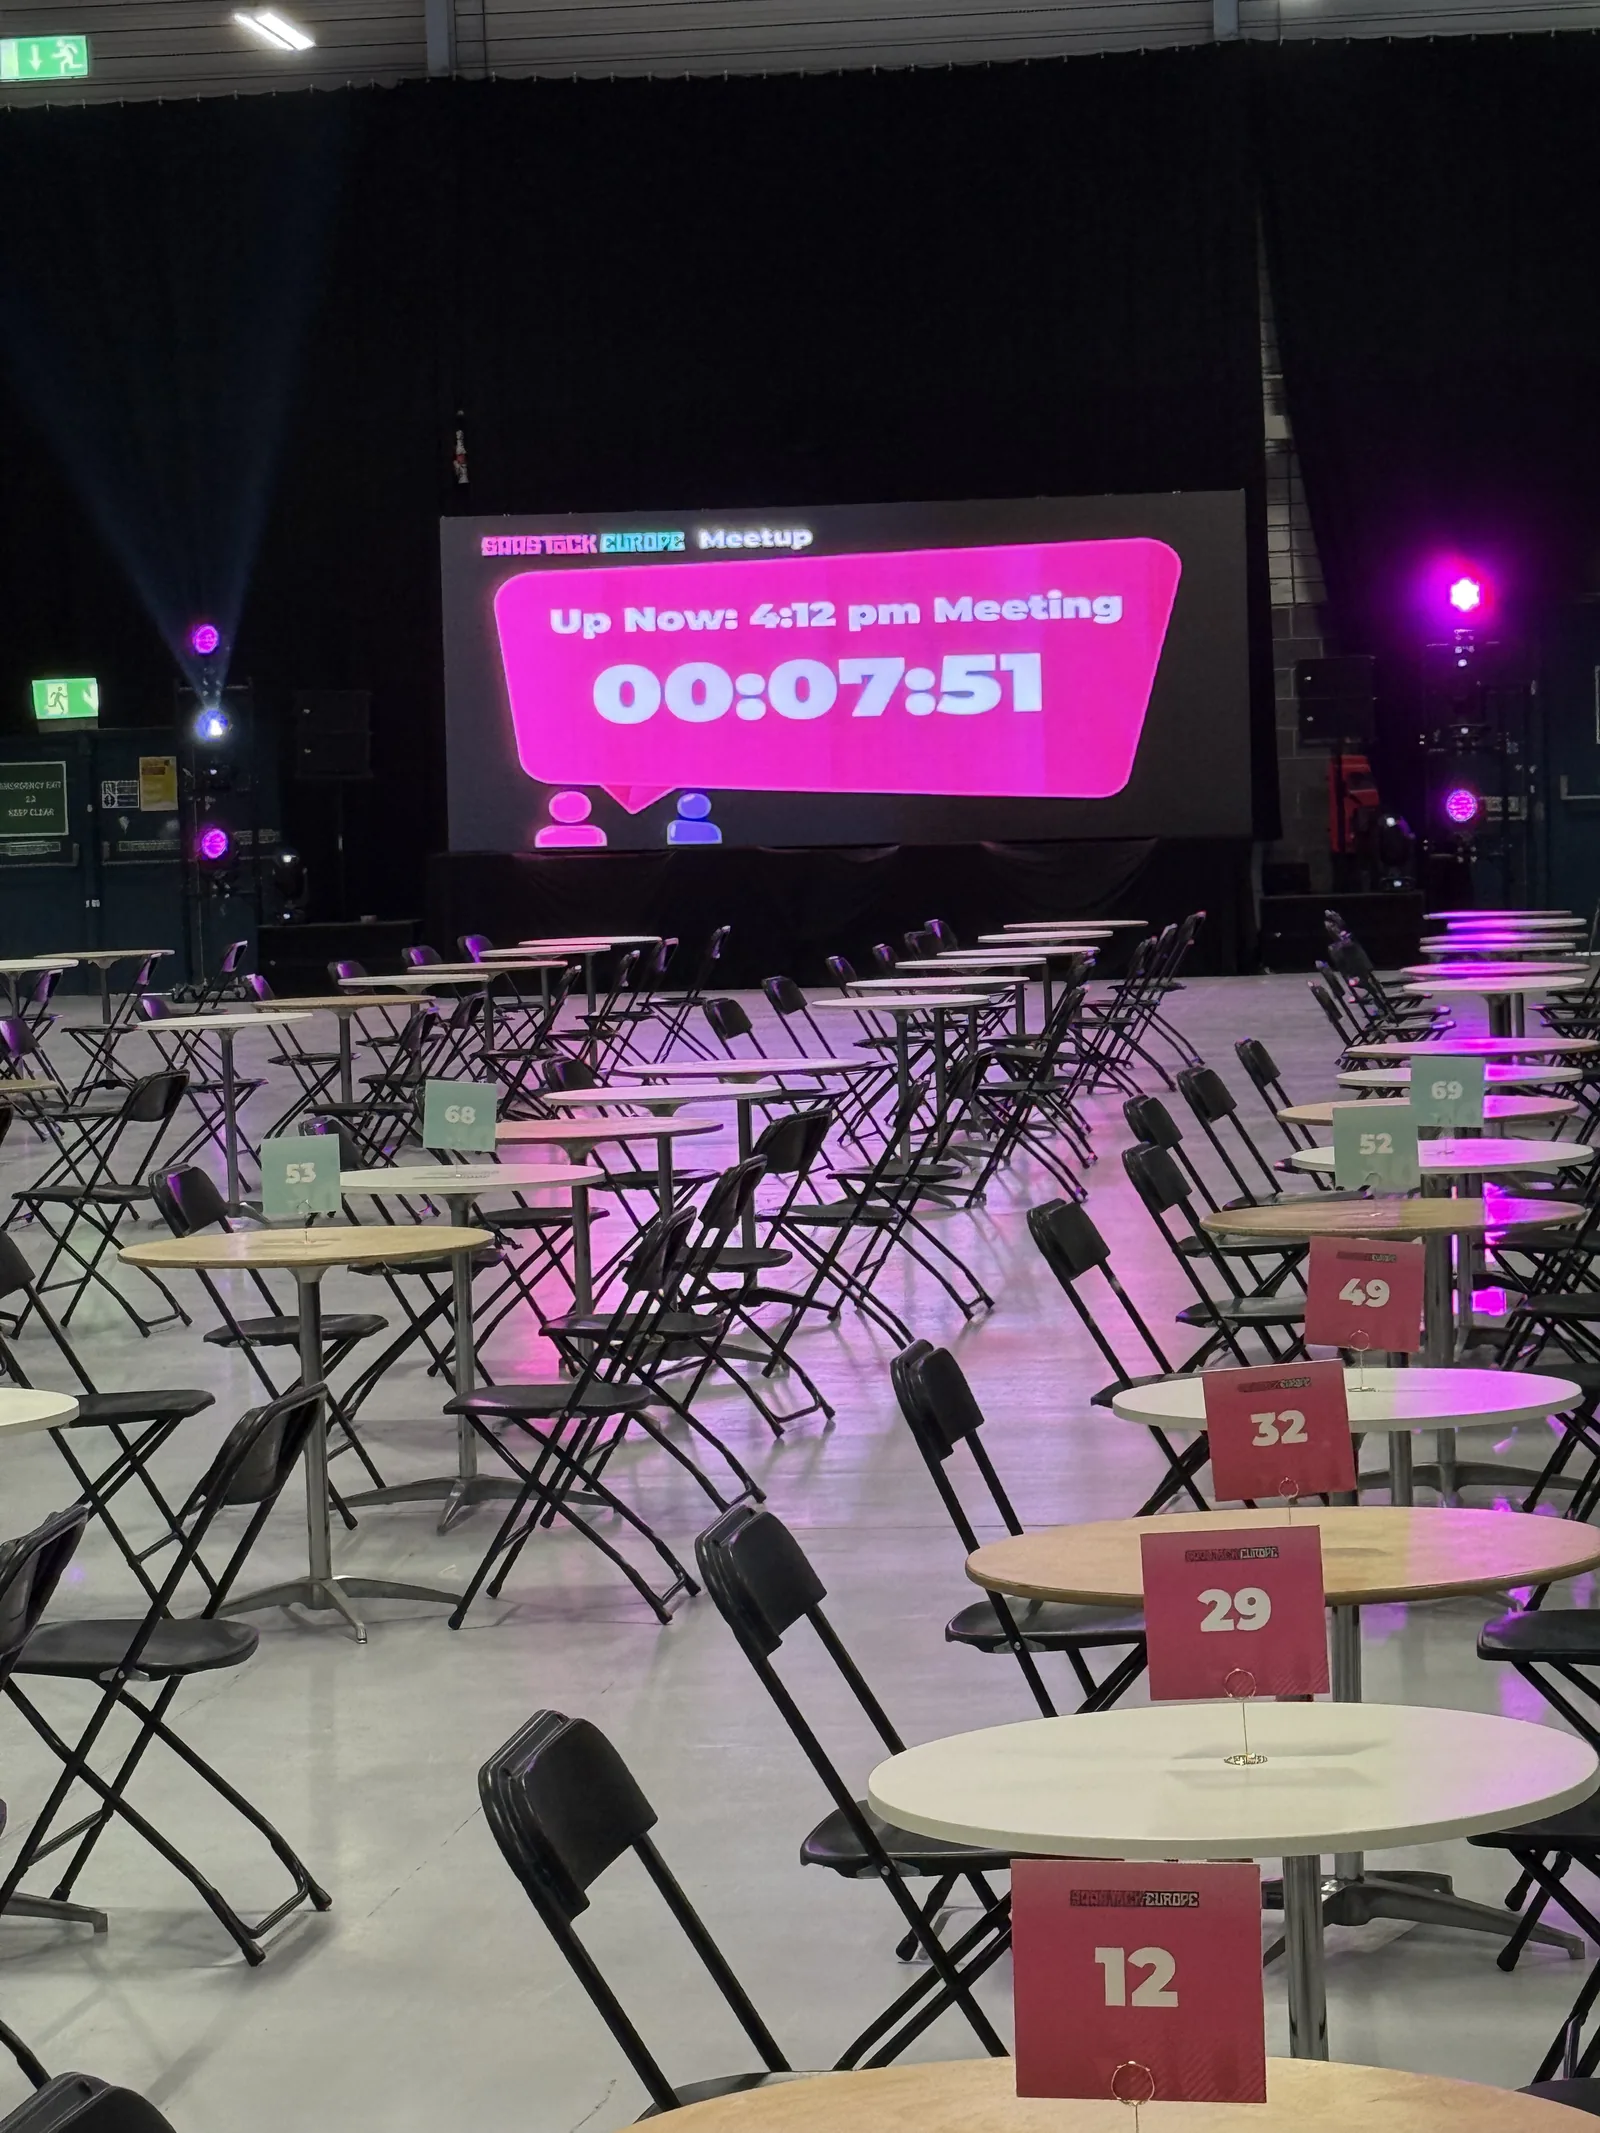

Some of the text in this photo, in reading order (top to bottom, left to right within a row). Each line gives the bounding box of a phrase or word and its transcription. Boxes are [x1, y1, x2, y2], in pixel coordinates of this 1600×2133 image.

[600, 531, 686, 553] EUROPE
[698, 527, 814, 550] Meetup
[550, 590, 1123, 640] Up Now: 4:12 pm Meeting
[592, 652, 1043, 725] 00:07:51
[1431, 1080, 1463, 1100] 69
[444, 1105, 476, 1125] 68
[1359, 1132, 1394, 1155] 52
[285, 1162, 317, 1184] 53
[1338, 1278, 1390, 1308] 49
[1250, 1409, 1308, 1447] 32
[1197, 1587, 1272, 1632] 29
[1144, 1891, 1199, 1908] EUROPE
[1094, 1946, 1179, 2008] 12
